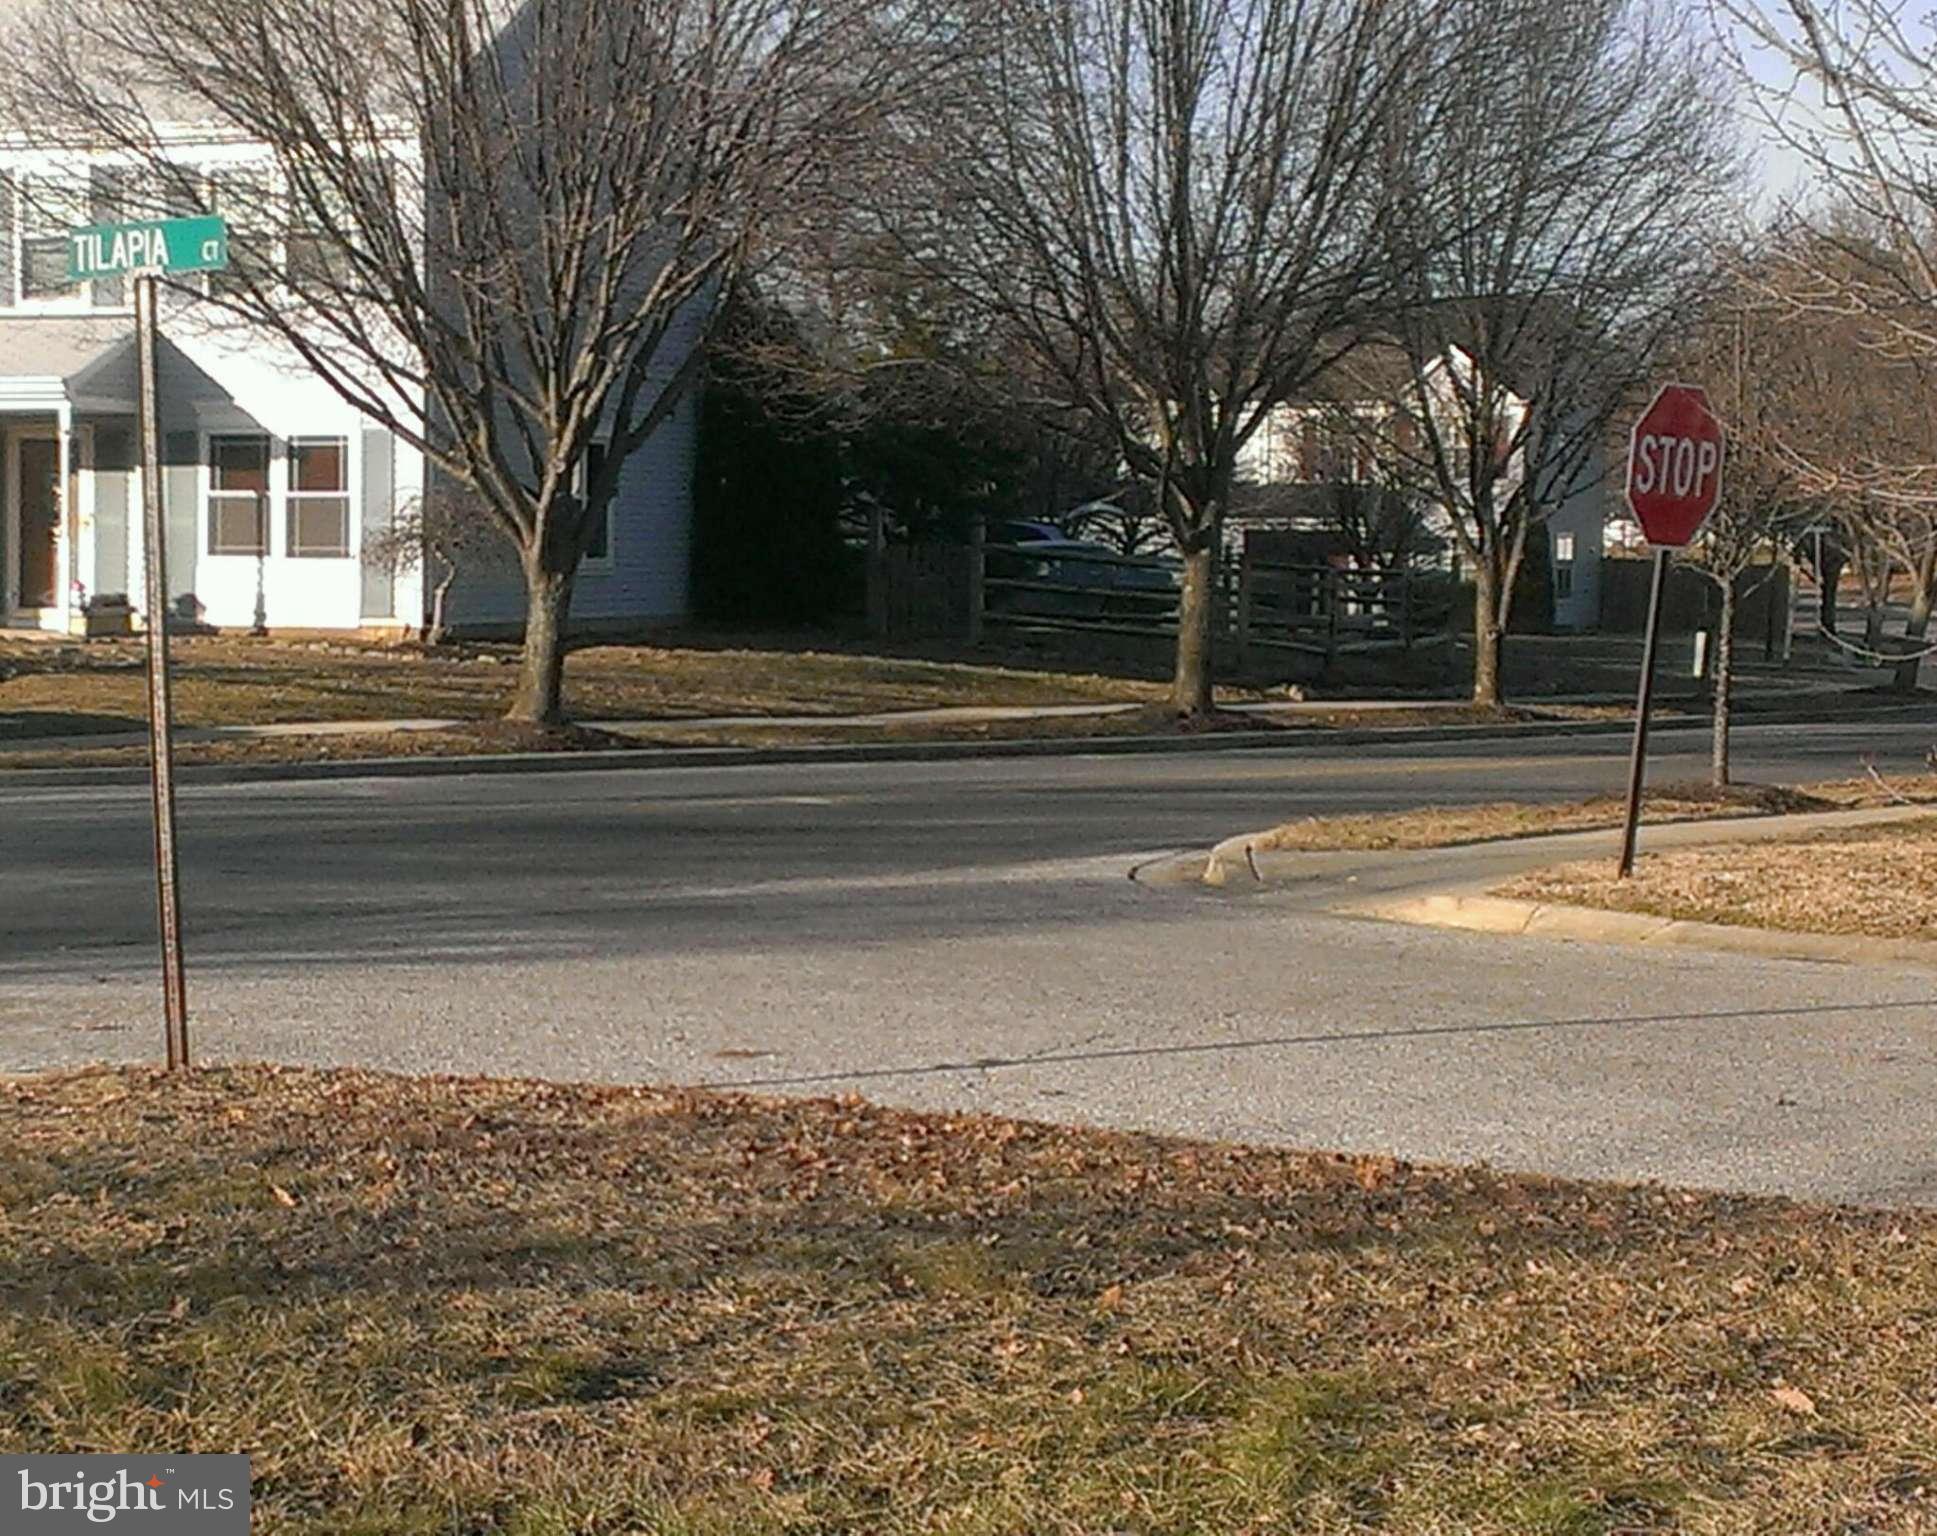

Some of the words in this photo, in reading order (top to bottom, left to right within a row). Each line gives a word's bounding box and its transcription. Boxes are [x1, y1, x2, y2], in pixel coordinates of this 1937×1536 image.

[73, 228, 169, 272] TILAPIA
[202, 240, 219, 261] CT
[1636, 435, 1717, 498] STOP
